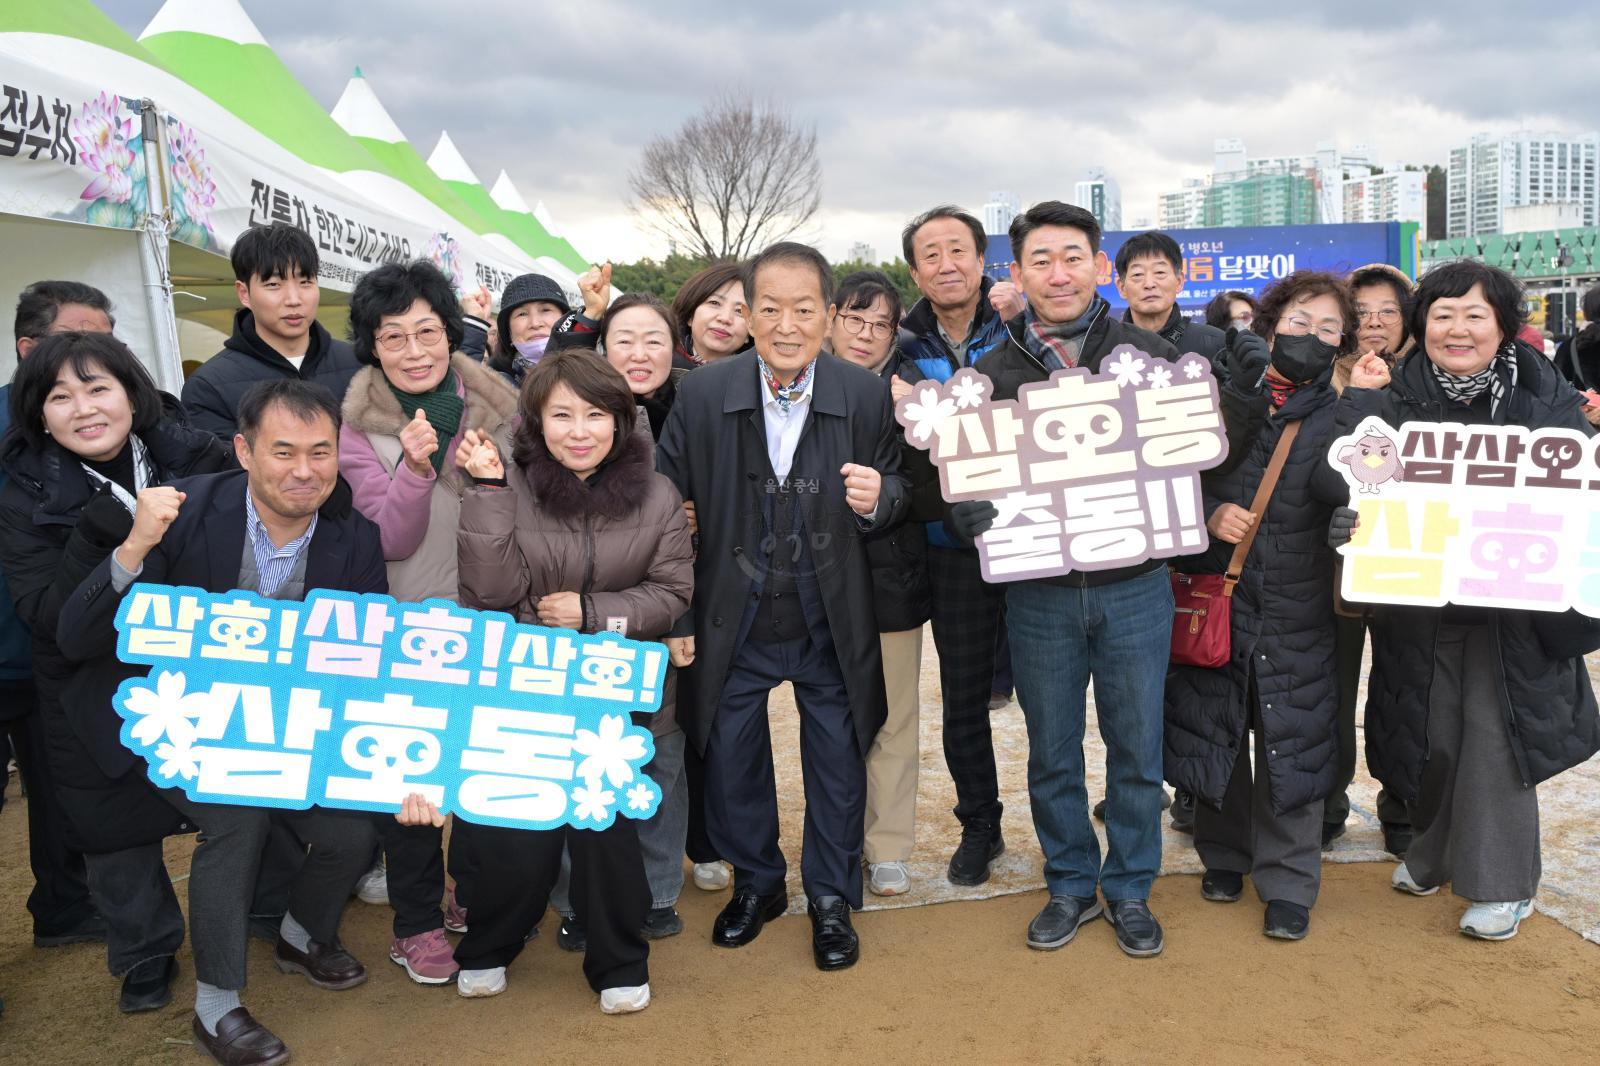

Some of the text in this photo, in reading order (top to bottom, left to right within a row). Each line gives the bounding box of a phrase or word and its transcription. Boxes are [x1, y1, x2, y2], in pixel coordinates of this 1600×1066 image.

[0, 84, 77, 165] 접수처
[313, 204, 343, 254] 한잔
[1189, 241, 1224, 254] 병오년
[1219, 254, 1295, 281] 달맞이
[936, 374, 1222, 494] 삼호동
[1401, 430, 1600, 491] 삼삼오
[983, 476, 1202, 575] 출동!!
[1349, 499, 1600, 608] 삼호
[126, 591, 663, 704] 삼호! 삼호! 삼호!
[193, 681, 578, 824] 삼호동
